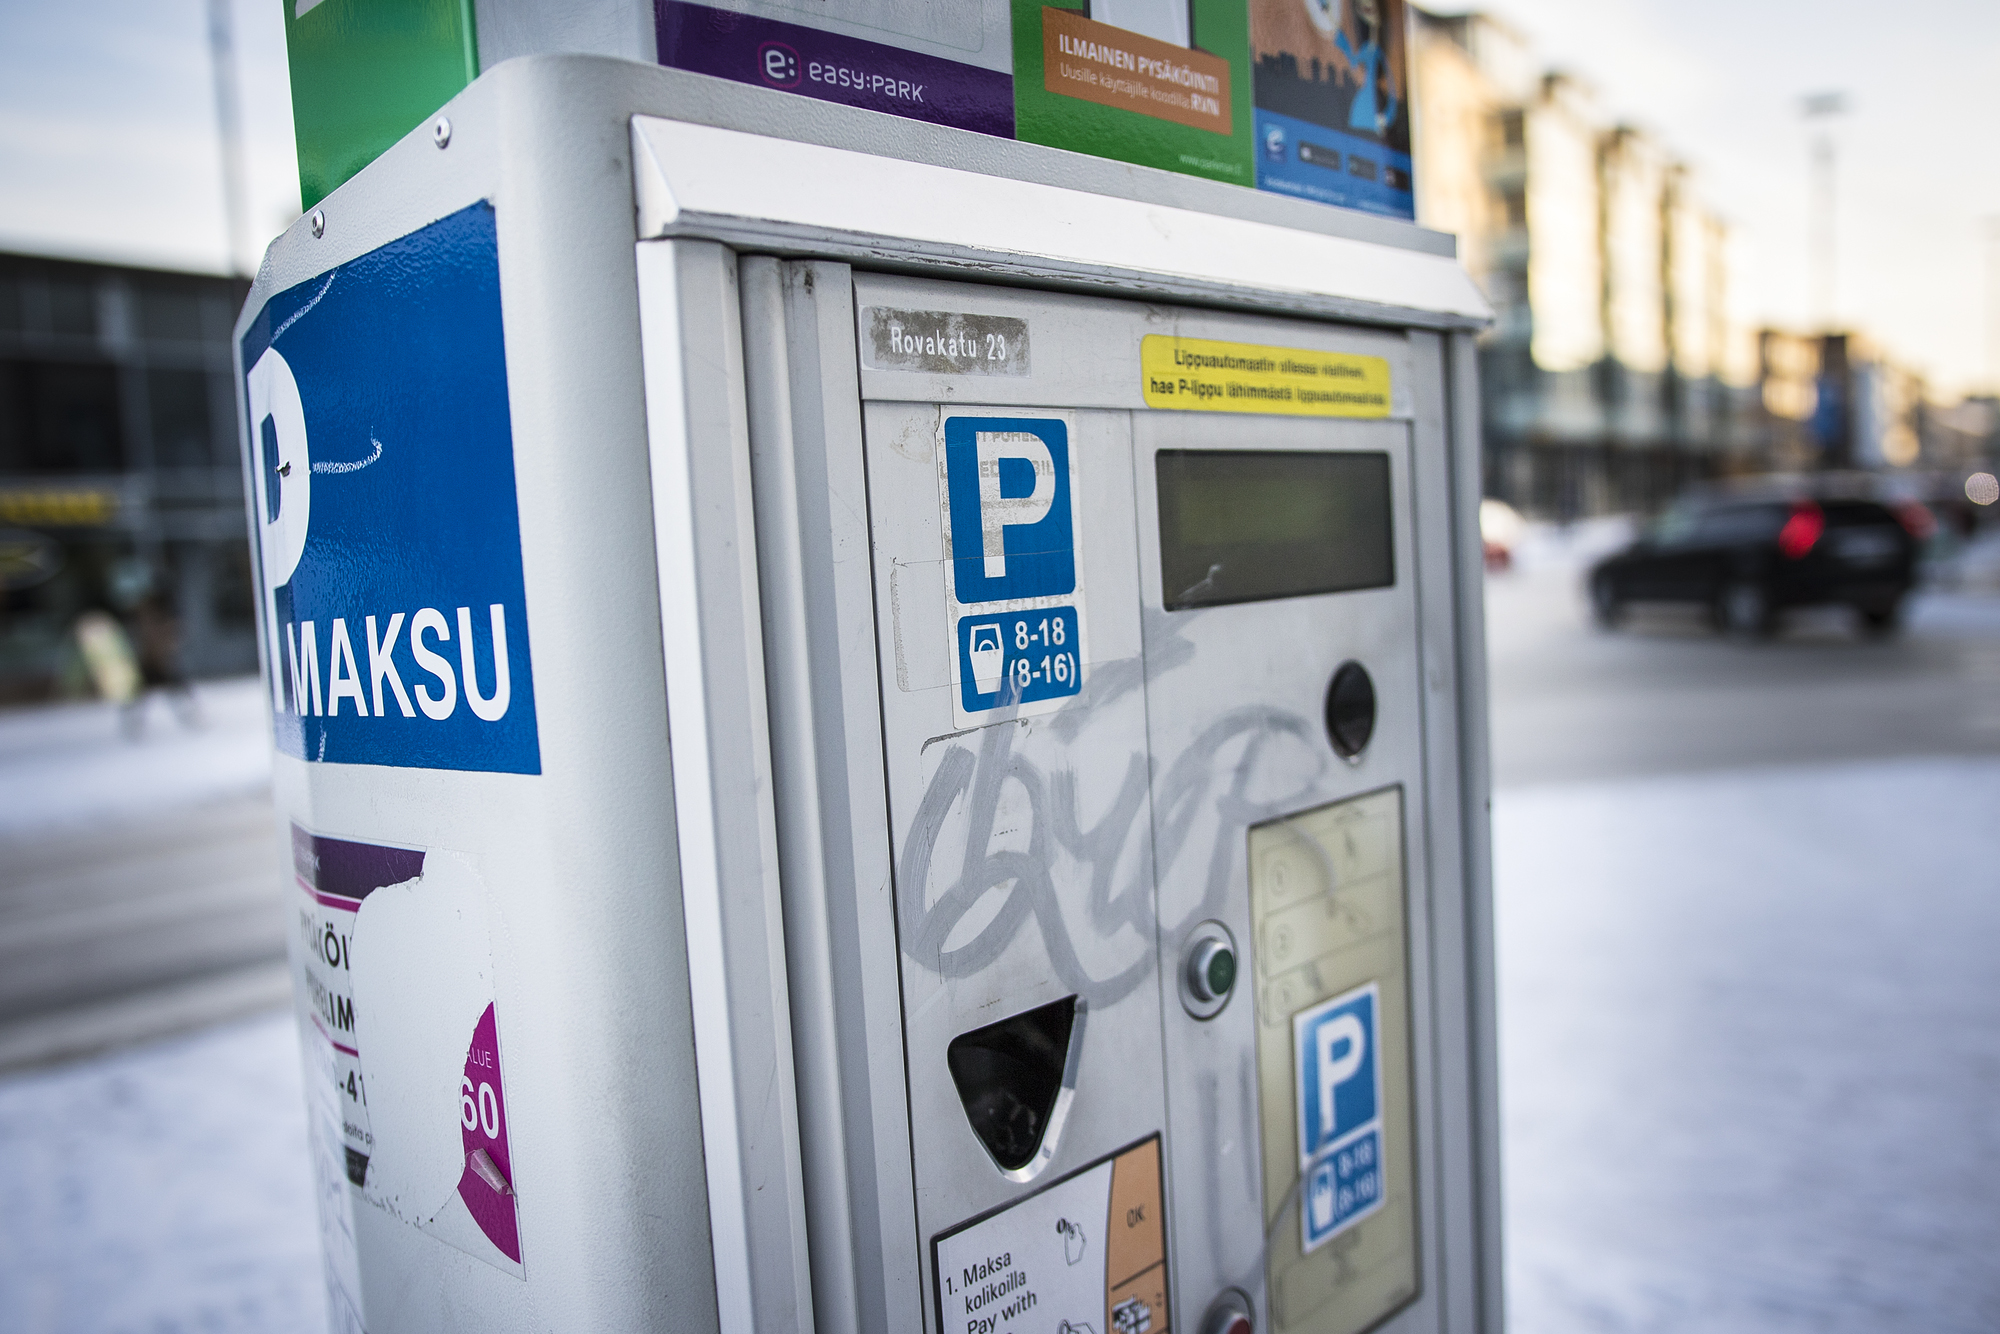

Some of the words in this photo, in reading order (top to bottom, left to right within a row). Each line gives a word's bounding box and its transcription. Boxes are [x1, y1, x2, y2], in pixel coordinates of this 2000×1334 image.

[1059, 34, 1135, 71] ILMAINEN
[1137, 58, 1219, 94] PYSÄKÖINTI
[1060, 62, 1097, 85] Uusille
[1099, 72, 1149, 99] käyttäjille
[891, 327, 977, 358] Rovakatu
[986, 333, 1006, 361] 23
[1174, 349, 1276, 373] Lippuautomaatin
[1150, 377, 1174, 394] hae
[1178, 379, 1223, 401] P-lippu
[1226, 380, 1292, 401] lähimmästä
[975, 431, 1056, 578] P
[246, 347, 310, 713] P
[1015, 617, 1066, 650] 8-18
[287, 603, 511, 721] MAKSU
[1009, 652, 1076, 697] (8-16)
[1316, 1012, 1365, 1135] P
[460, 1075, 499, 1139] 60
[1126, 1203, 1147, 1229] OK
[945, 1276, 959, 1296] 1.
[963, 1252, 1012, 1288] Maksa
[965, 1270, 1027, 1315] kolikoilla
[967, 1313, 998, 1334] Pay
[1001, 1290, 1038, 1321] with
